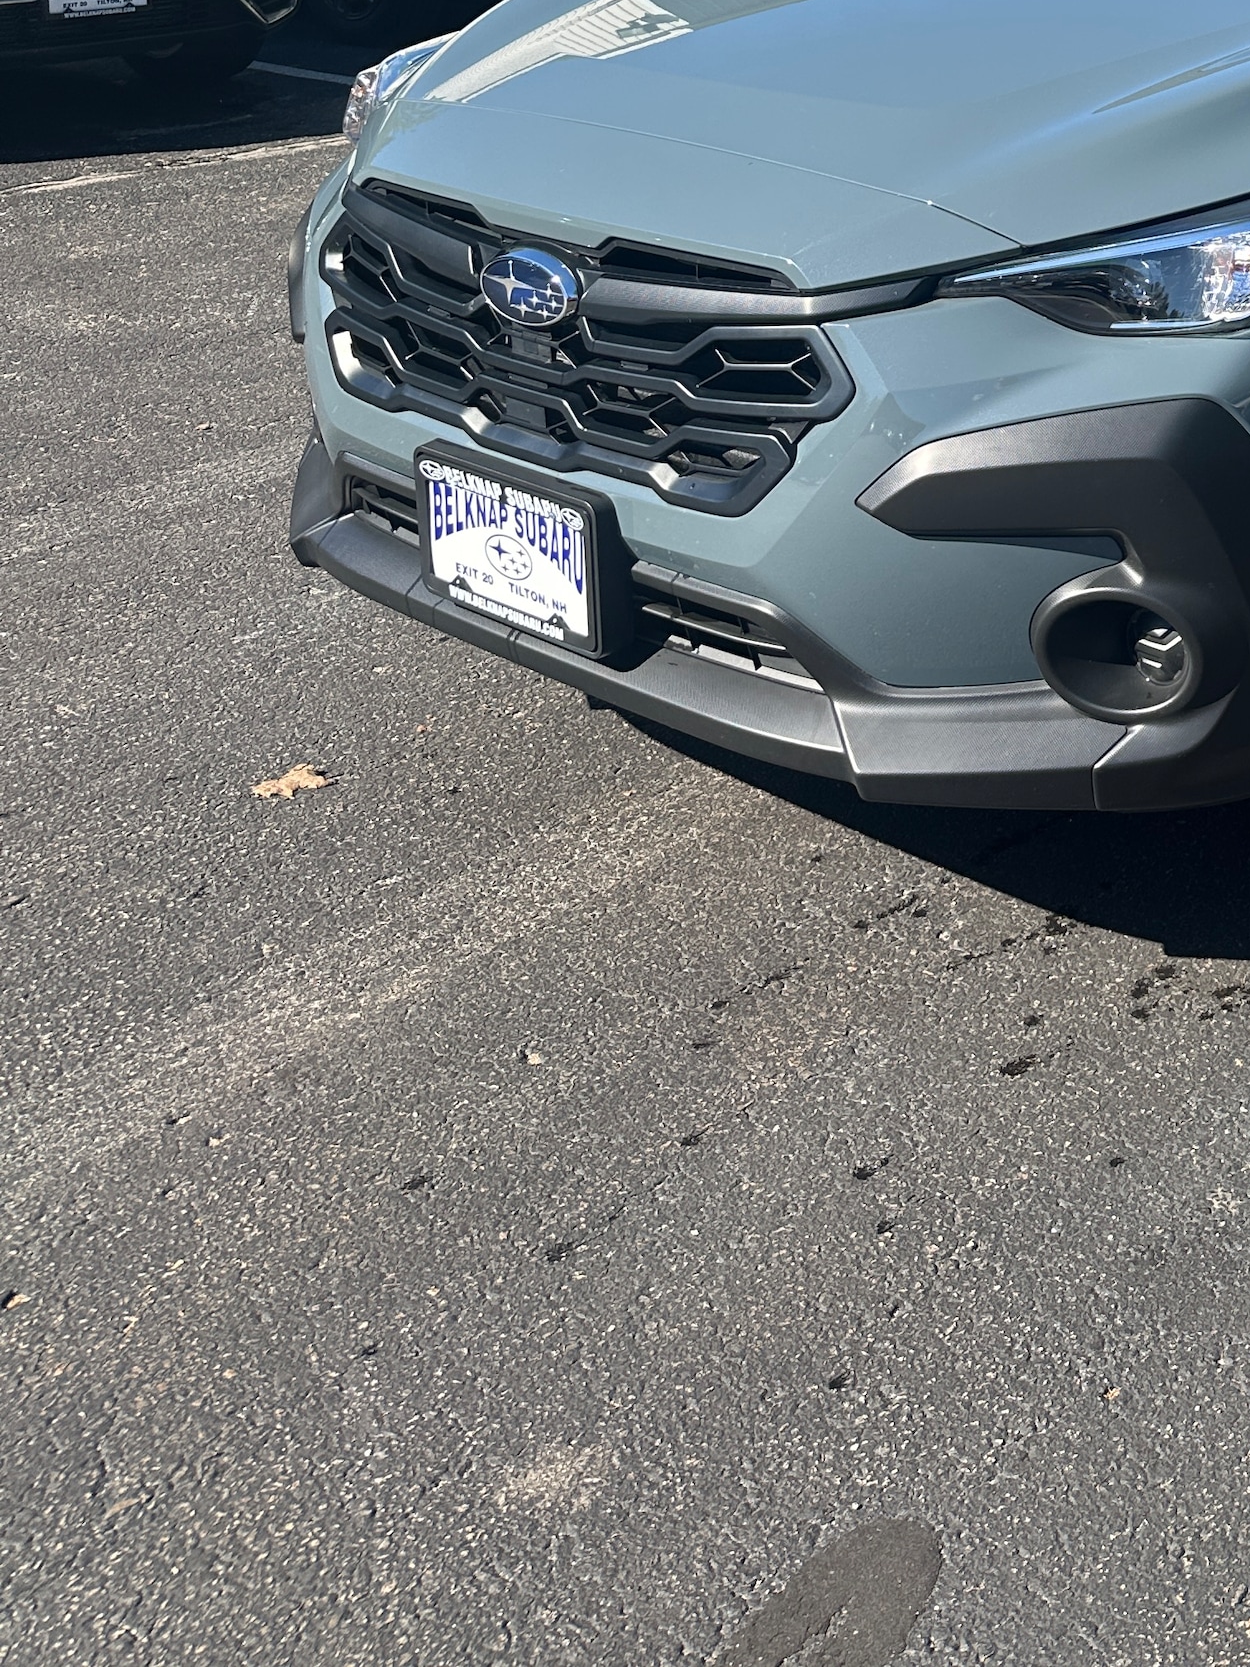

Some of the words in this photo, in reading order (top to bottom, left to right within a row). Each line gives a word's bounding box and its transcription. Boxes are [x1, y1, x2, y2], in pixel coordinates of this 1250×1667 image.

[442, 465, 502, 501] BELKNAP
[504, 486, 562, 523] SUBARU
[433, 481, 508, 541] BELKNAP
[514, 507, 586, 595] SUBARU
[455, 562, 478, 580] EXIT
[482, 572, 494, 585] 20
[508, 582, 550, 609] TILTON,
[552, 598, 567, 614] NH
